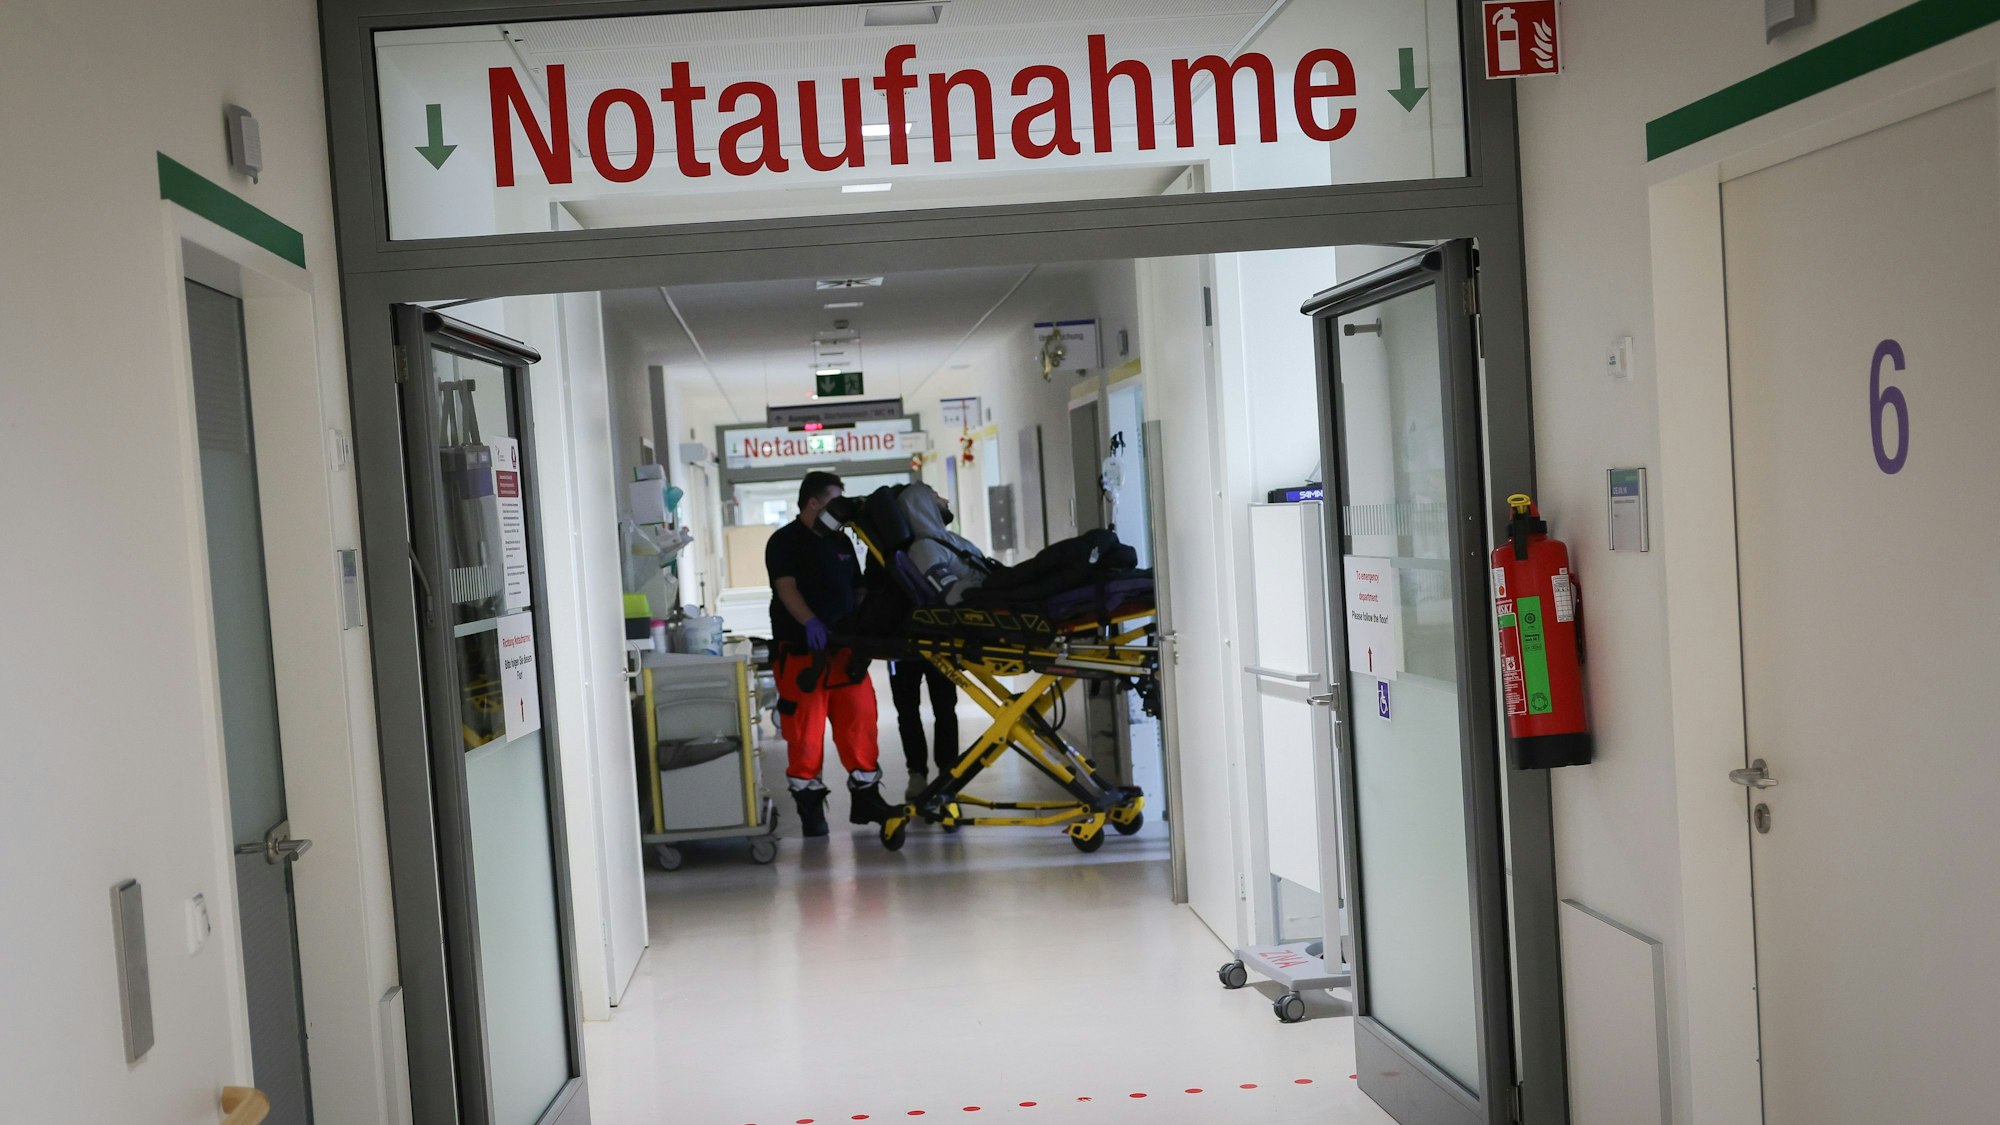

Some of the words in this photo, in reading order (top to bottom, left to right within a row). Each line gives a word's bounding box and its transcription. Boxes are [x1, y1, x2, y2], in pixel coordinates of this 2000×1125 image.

[487, 33, 1358, 188] Notaufnahme
[1869, 338, 1910, 476] 6
[743, 431, 895, 459] Notauahme
[1355, 570, 1361, 580] To
[1361, 573, 1379, 584] emergency
[1352, 610, 1363, 621] Please
[1362, 611, 1373, 622] follow
